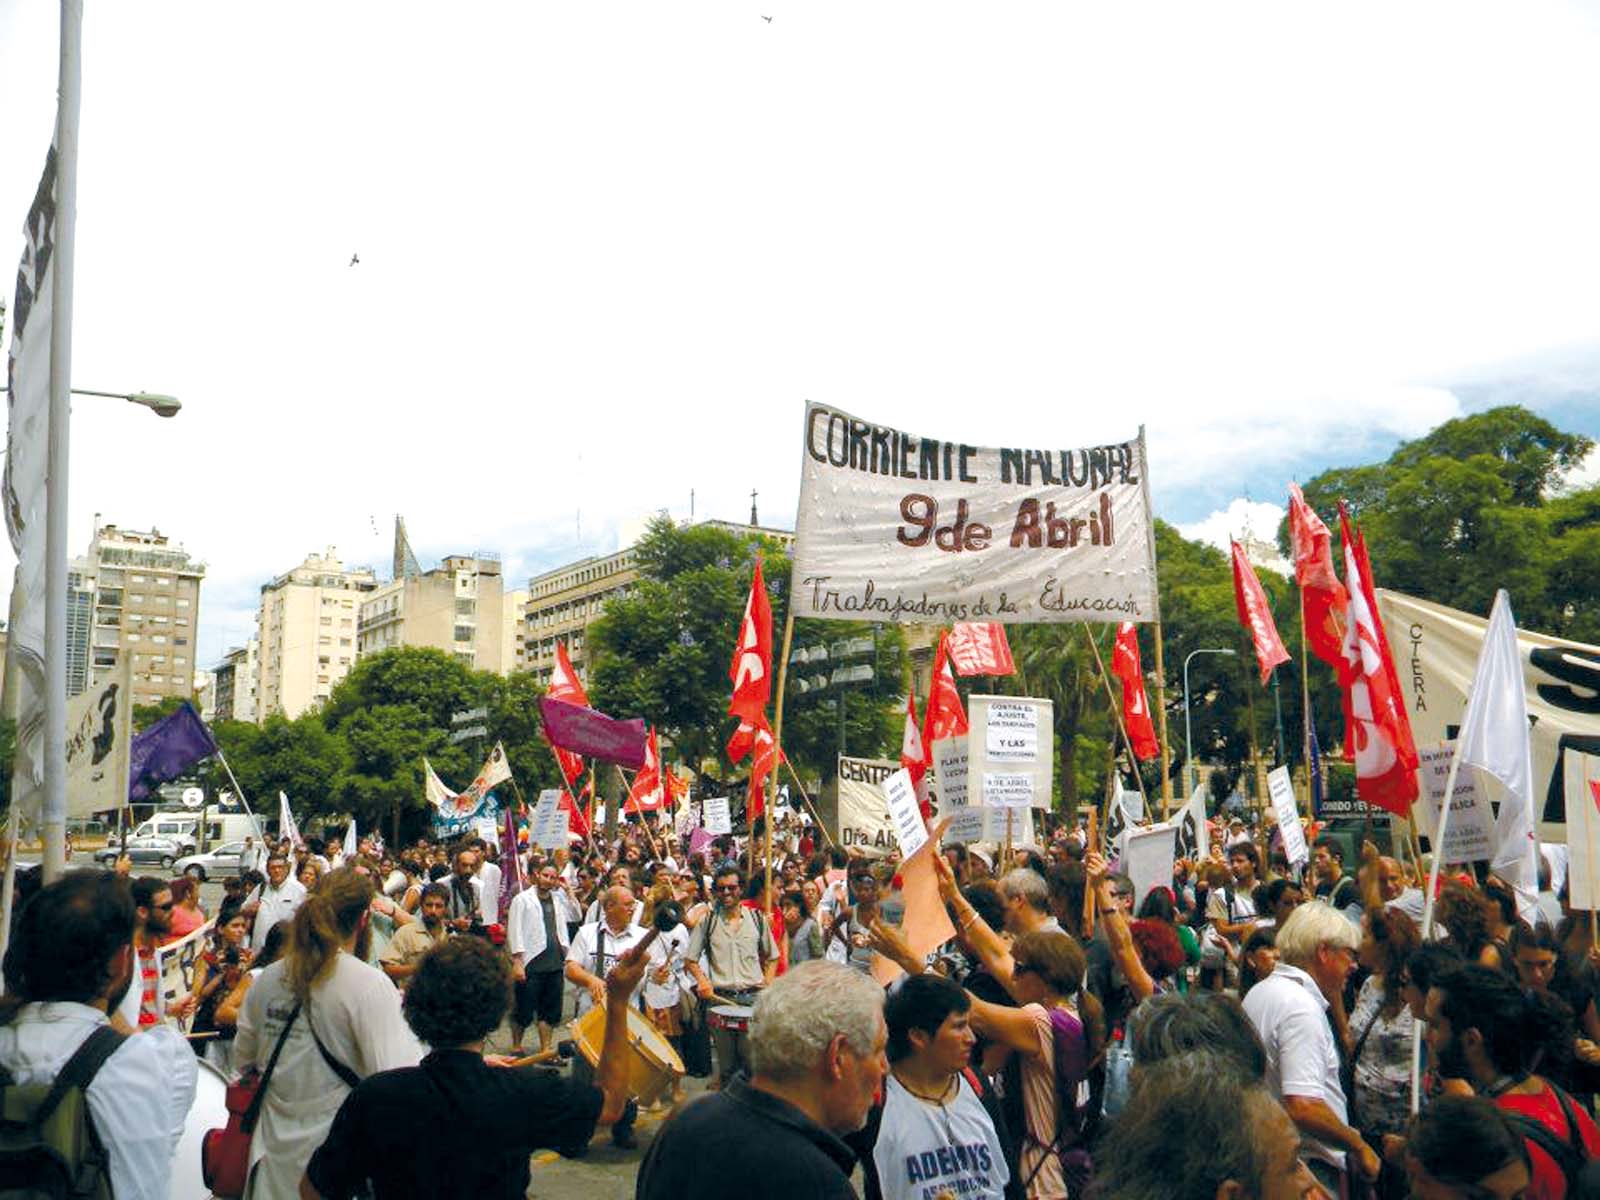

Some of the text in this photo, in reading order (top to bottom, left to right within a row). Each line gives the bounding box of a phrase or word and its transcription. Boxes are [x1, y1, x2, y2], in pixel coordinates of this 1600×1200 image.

[807, 407, 978, 483] CORRIENTE
[1009, 491, 1114, 548] Abril
[971, 596, 992, 616] de
[996, 596, 1018, 614] la
[1410, 623, 1427, 711] CTERA
[1000, 739, 1025, 747] Y LAS
[906, 1144, 992, 1184] ADEMYS
